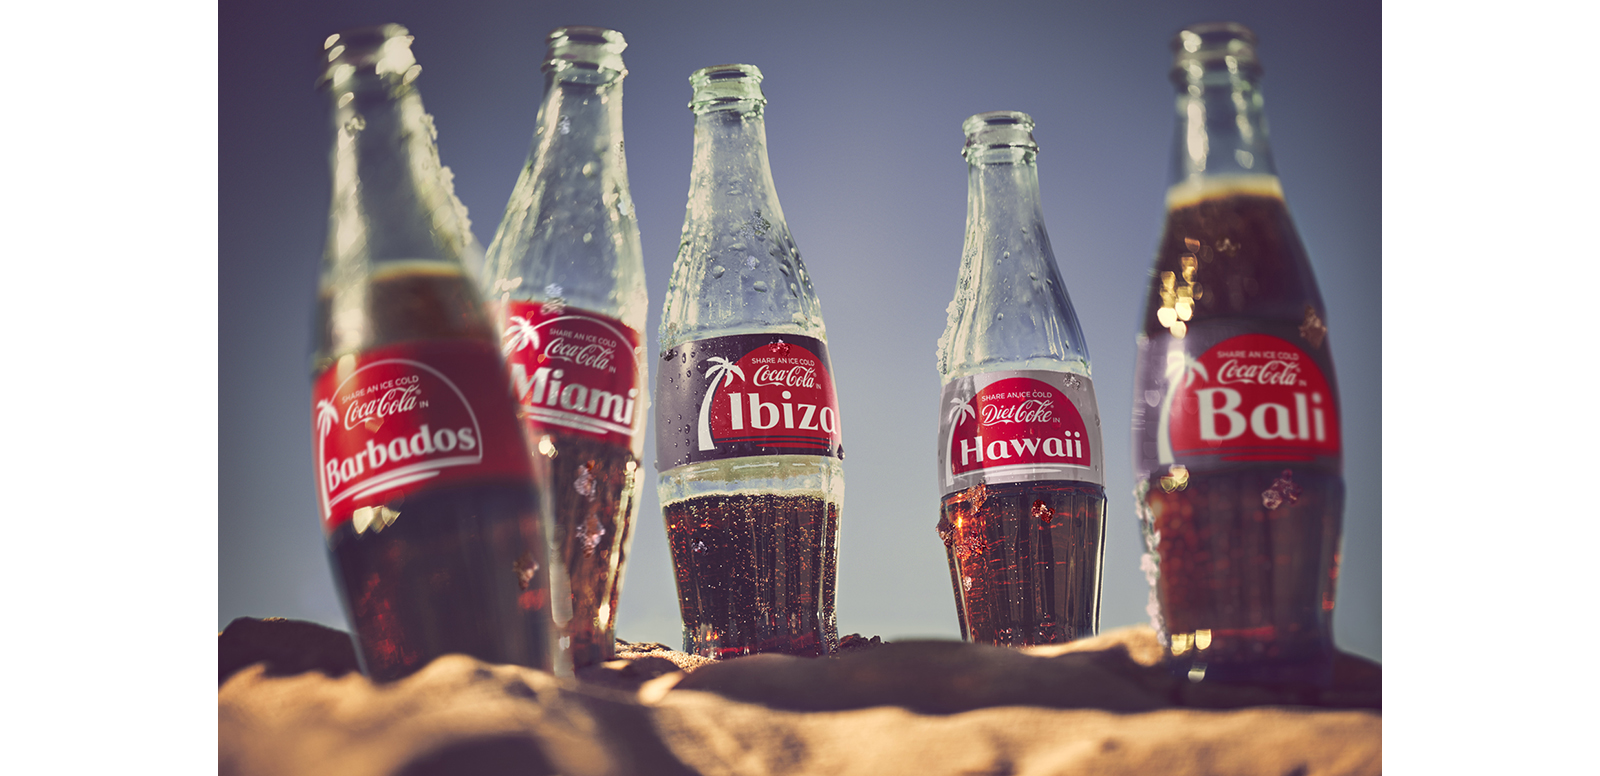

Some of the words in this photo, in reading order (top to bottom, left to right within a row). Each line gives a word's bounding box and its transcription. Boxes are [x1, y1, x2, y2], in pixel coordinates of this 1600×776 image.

[549, 328, 572, 339] SHARE
[573, 332, 585, 341] AN
[585, 334, 597, 343] ICE
[598, 337, 617, 348] COLD
[544, 337, 616, 371] Coca-Cola
[608, 365, 617, 374] IN
[751, 357, 776, 365] SHARE
[799, 358, 815, 367] COLD
[1217, 350, 1246, 359] SHARE
[1248, 351, 1262, 359] AN
[1263, 351, 1276, 360] ICE
[1277, 351, 1299, 361] COLD
[753, 364, 816, 389] Coca-Cola
[1217, 359, 1300, 386] Coca-Cola
[1298, 379, 1307, 387] IN
[342, 389, 365, 404] SHARE
[366, 384, 379, 394] AN
[380, 380, 394, 391] ICE
[395, 375, 419, 387] COLD
[509, 363, 639, 425] Miami
[981, 392, 1006, 402] SHARE
[344, 384, 420, 431] Coca-Cola
[419, 400, 429, 409] IN
[727, 390, 838, 435] Ibiza
[981, 404, 1016, 427] Diet
[1014, 399, 1054, 423] Coke
[1195, 387, 1326, 442] Bali
[325, 424, 476, 493] Barbados
[960, 430, 1083, 466] Hawaii
